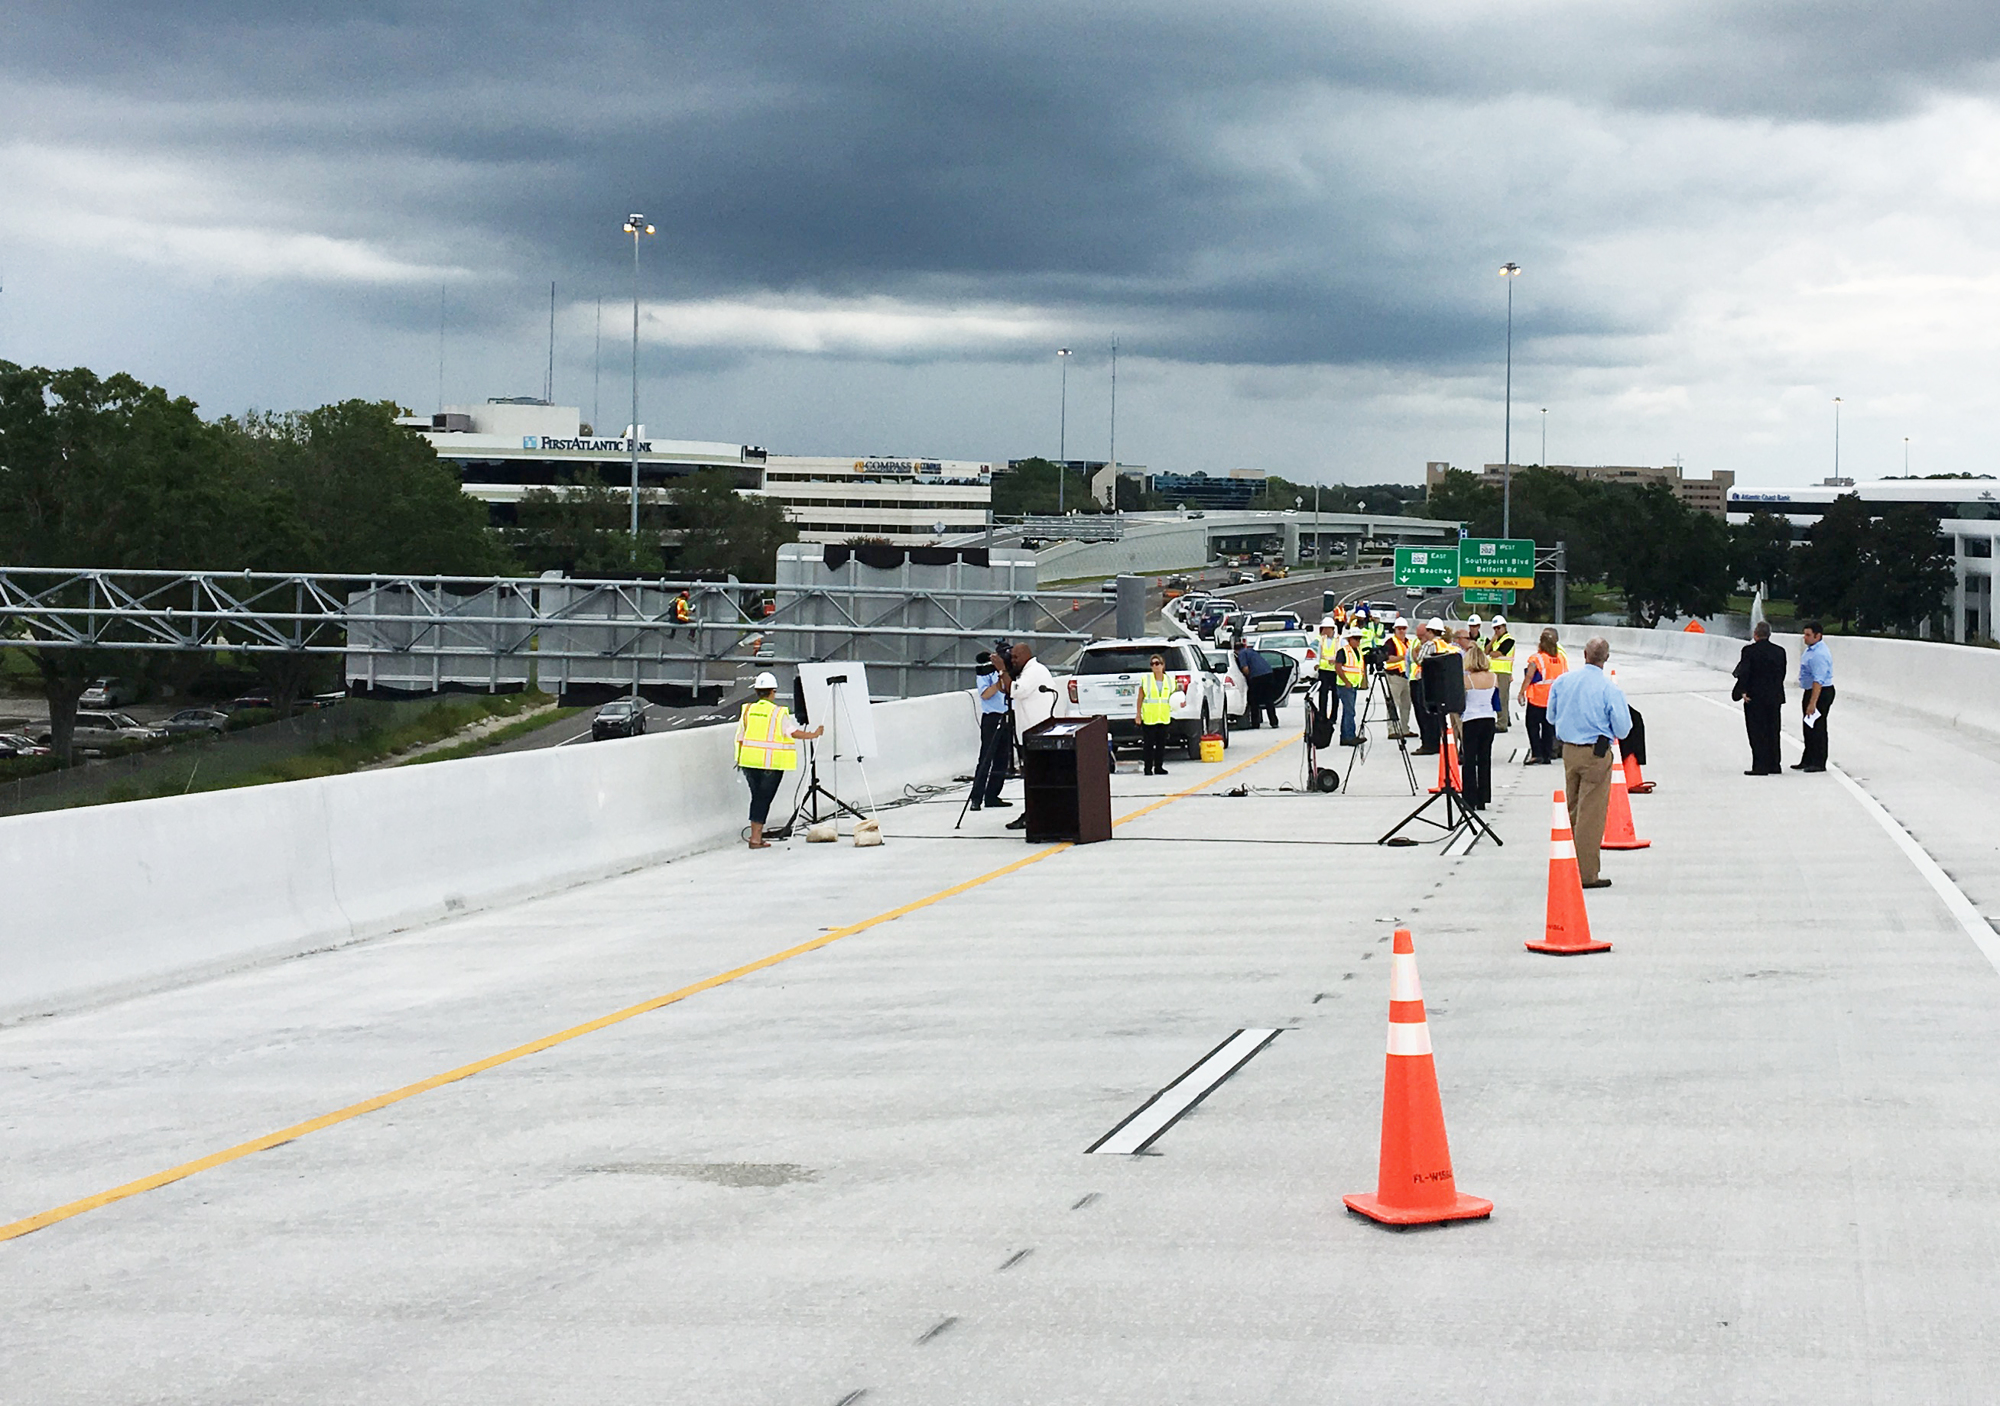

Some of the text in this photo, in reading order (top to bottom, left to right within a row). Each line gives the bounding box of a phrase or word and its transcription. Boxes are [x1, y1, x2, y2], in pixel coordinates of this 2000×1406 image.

[627, 439, 652, 452] BNK
[865, 461, 912, 470] COMPASS
[1465, 557, 1529, 566] Southpoint Blvd
